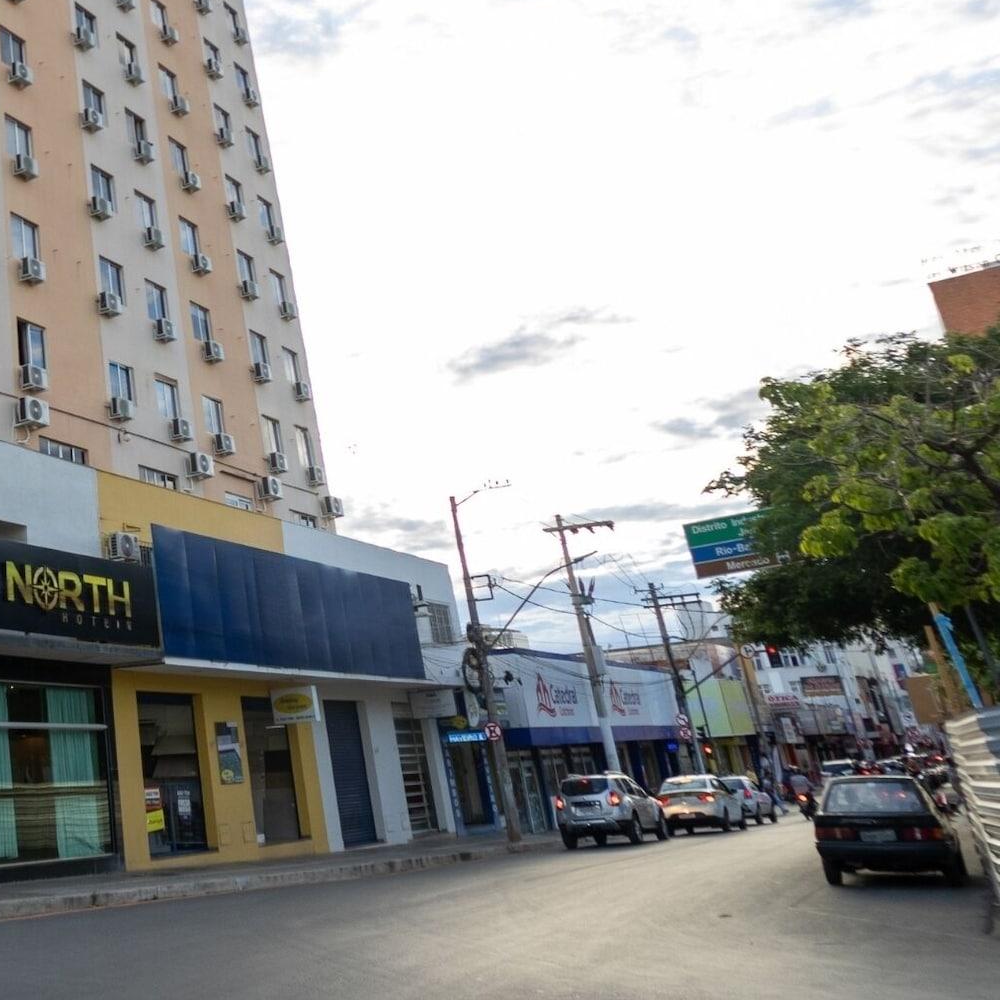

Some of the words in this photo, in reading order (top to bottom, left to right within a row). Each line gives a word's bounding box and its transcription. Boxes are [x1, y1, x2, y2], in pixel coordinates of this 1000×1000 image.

[691, 520, 728, 535] Distrito
[5, 560, 132, 618] NORTH
[61, 611, 133, 632] HOTEIS
[550, 683, 578, 705] Catedral
